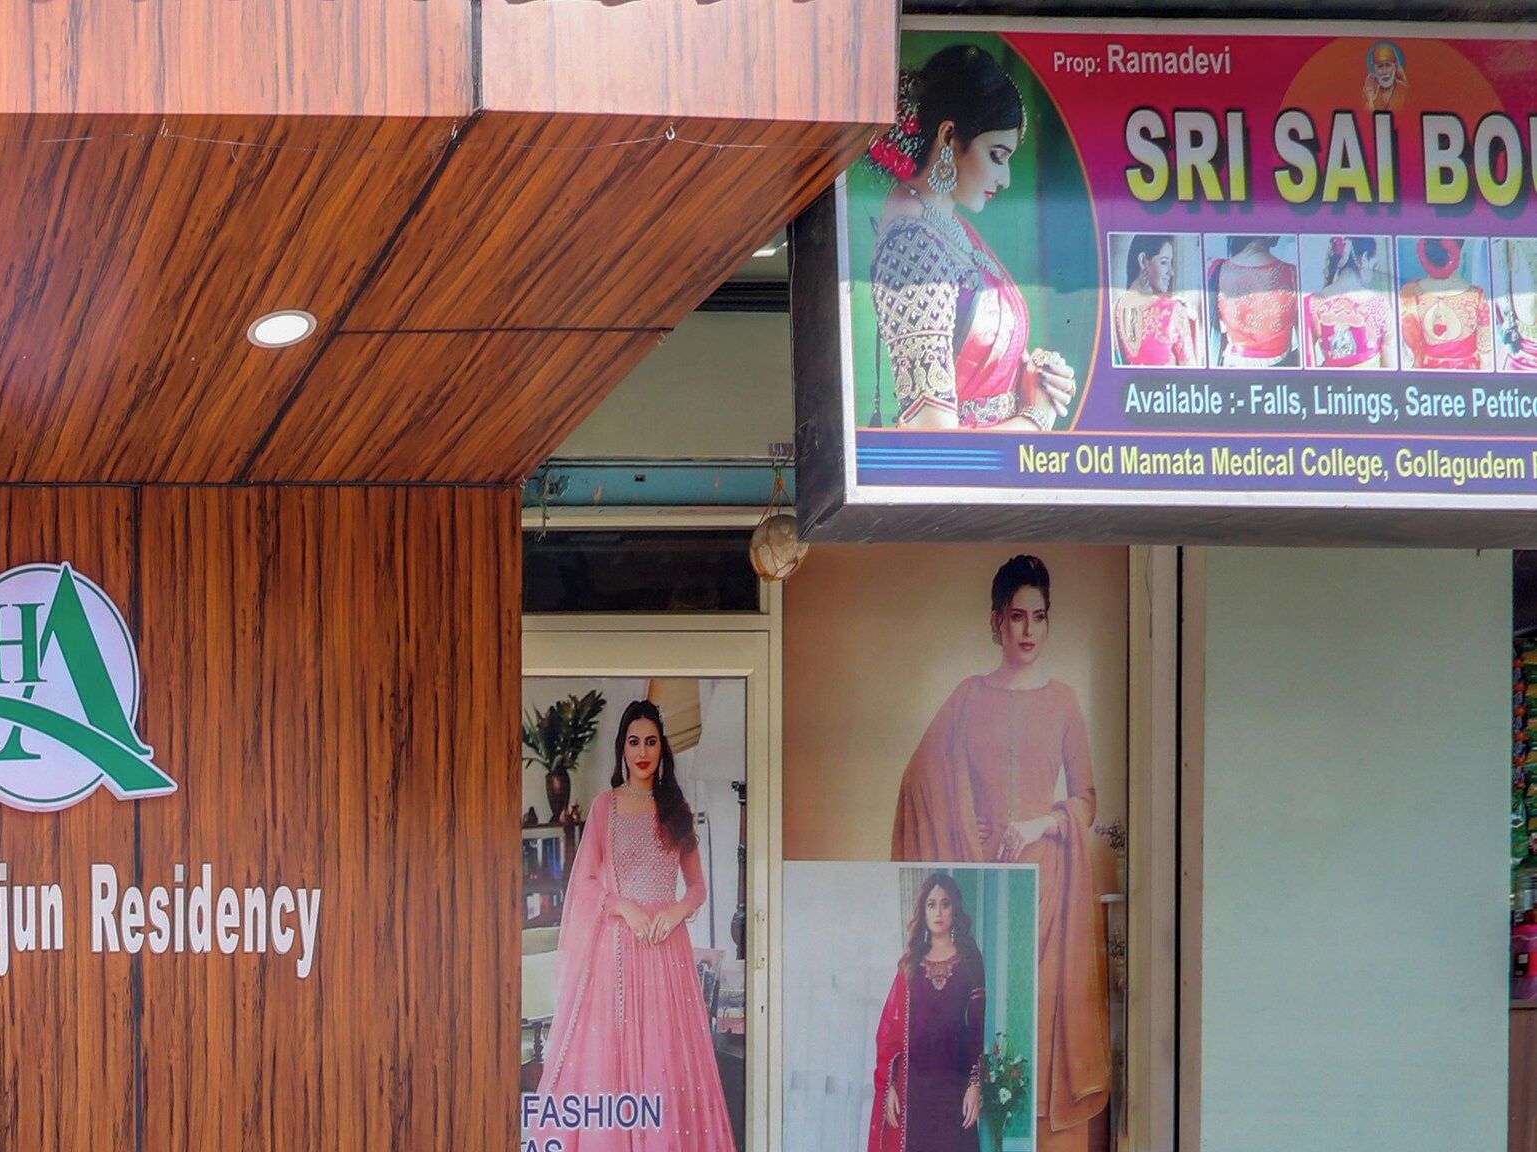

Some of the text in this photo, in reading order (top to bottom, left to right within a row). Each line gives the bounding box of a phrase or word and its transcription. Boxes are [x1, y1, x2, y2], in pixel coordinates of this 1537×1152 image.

[1054, 44, 1232, 76] Prop: Ramadevi
[1124, 108, 1537, 208] SRI SAI BO
[1125, 383, 1223, 415] Available
[1250, 385, 1307, 419] Falls,
[1314, 385, 1398, 423] Linings,
[1405, 386, 1467, 418] Saree
[1019, 444, 1070, 474] Near
[1075, 444, 1114, 475] Old
[1120, 446, 1205, 476] Mamata
[1211, 447, 1295, 477] Medical
[1301, 447, 1389, 484] College,
[1395, 449, 1526, 485] Gollagudem
[91, 863, 322, 978] Residency
[522, 1095, 662, 1128] FASHION
